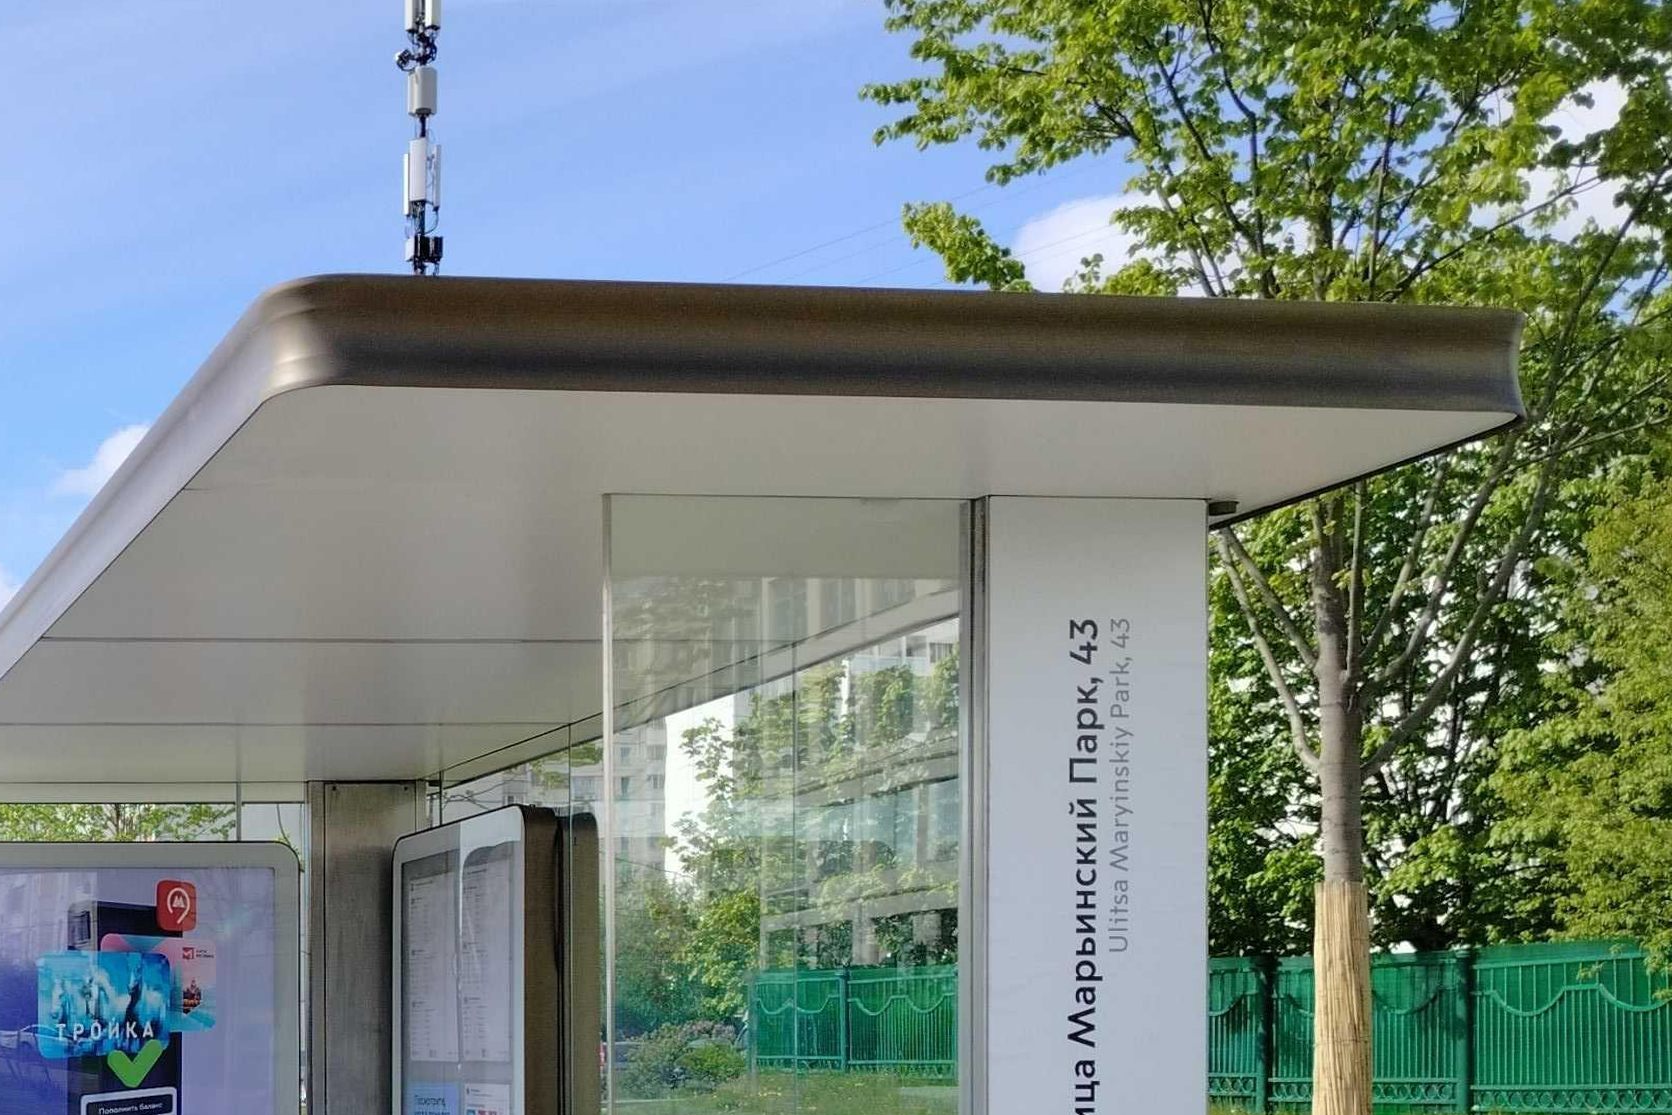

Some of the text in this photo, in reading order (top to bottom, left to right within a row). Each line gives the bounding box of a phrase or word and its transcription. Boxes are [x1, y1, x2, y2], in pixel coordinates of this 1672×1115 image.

[1069, 619, 1098, 665] 43
[1069, 677, 1105, 783] Парк,
[1108, 618, 1134, 952] Ulitsa Maryinskiy Park, 43
[1067, 798, 1103, 1048] Марьинский
[54, 1017, 155, 1041] ТРОЙКА
[98, 1102, 163, 1115] Пополнить баланс
